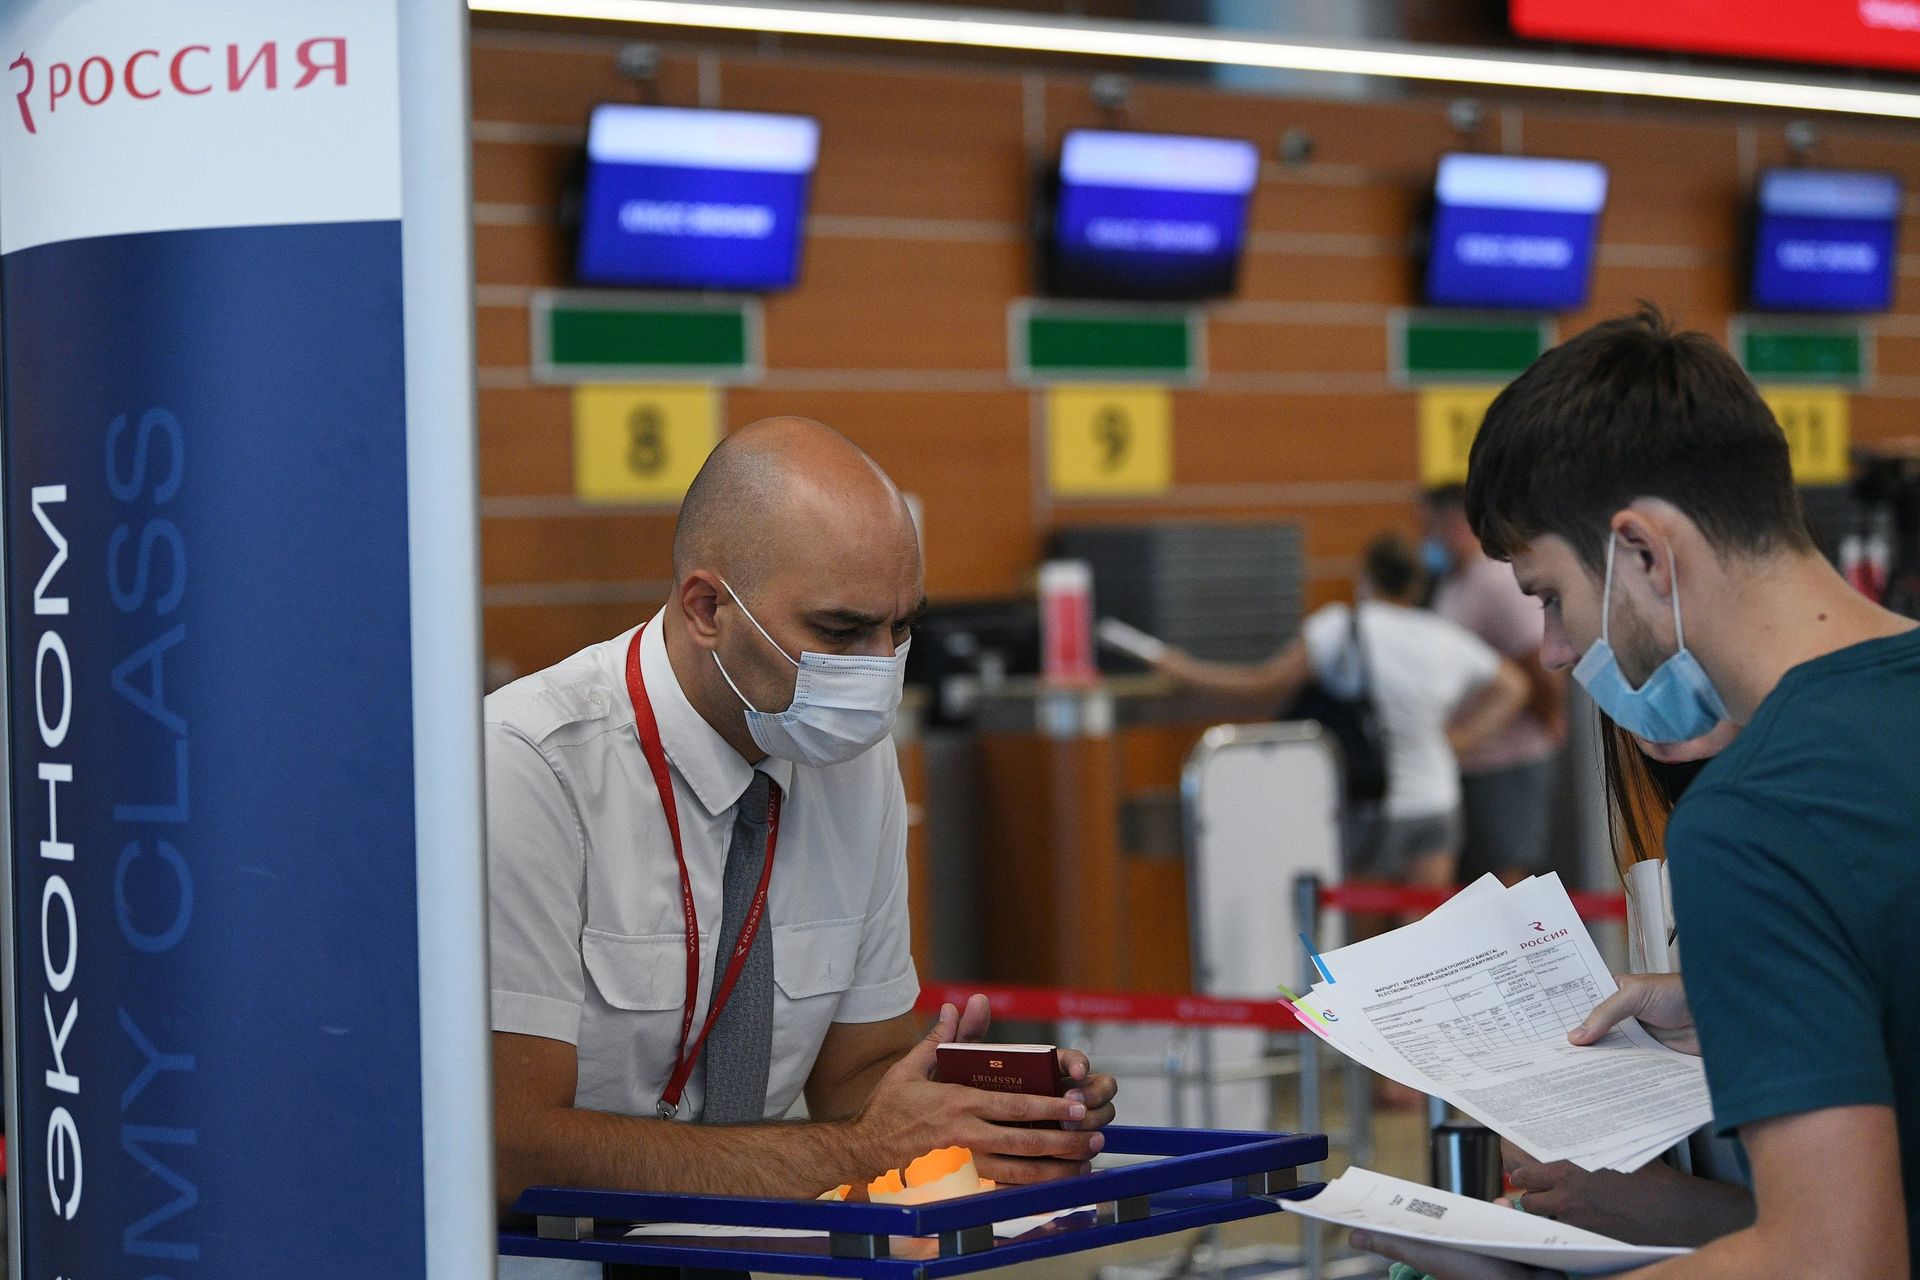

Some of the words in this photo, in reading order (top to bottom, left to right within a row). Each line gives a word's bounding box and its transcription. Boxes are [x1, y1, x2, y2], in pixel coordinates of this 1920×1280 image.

[49, 37, 348, 112] РОССИЯ
[626, 402, 668, 480] 8
[1090, 403, 1132, 477] 9
[104, 406, 194, 954] CLASS
[31, 484, 82, 1221] ЭКОНОМ
[1520, 928, 1568, 950] РОССИЯ
[971, 1074, 1022, 1085] PASSPORT
